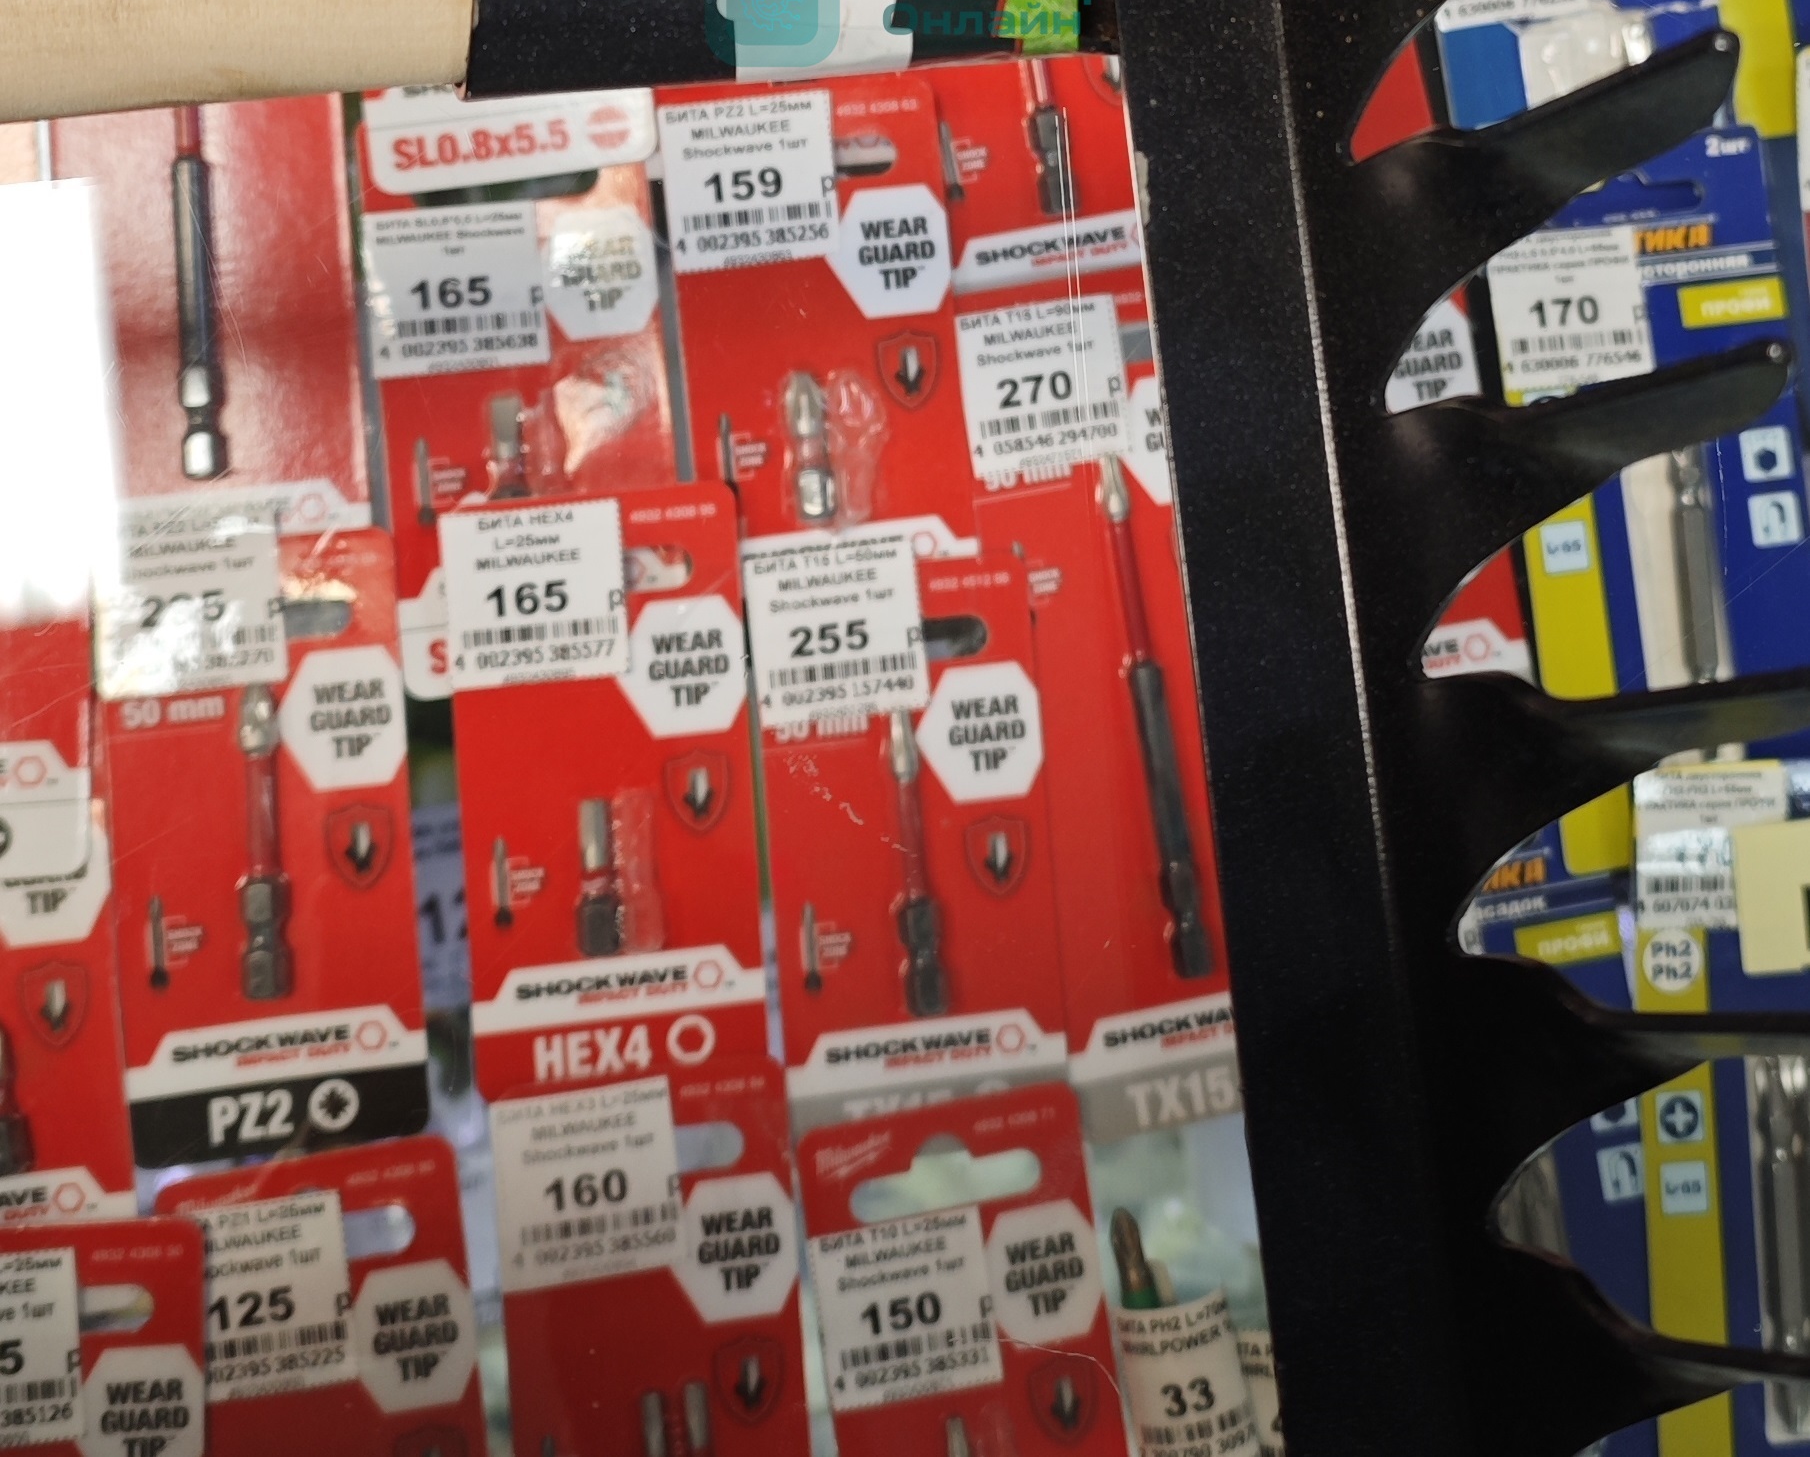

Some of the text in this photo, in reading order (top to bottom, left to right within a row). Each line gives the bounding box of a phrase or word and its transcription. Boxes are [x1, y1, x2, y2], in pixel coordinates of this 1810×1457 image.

[665, 100, 812, 124] БИТА PZ2 L=25мм
[691, 119, 790, 141] MILWAUKEE
[392, 119, 571, 171] SL0.8x5.5
[683, 139, 773, 160] Shockwave
[704, 167, 783, 203] 159
[696, 228, 762, 252] 002395
[860, 216, 927, 241] WEAR
[858, 240, 935, 266] GUARD
[975, 226, 1126, 266] SHOCKWAVE
[880, 266, 918, 290] TIP
[411, 275, 492, 311] 165
[960, 315, 1001, 331] БИТА
[1528, 295, 1600, 329] 170
[984, 321, 1077, 347] MILWAUKEE
[976, 344, 1061, 367] Shockwave
[996, 370, 1072, 409] 270
[1412, 378, 1448, 401] TIP
[477, 516, 524, 531] БИТА
[475, 548, 581, 572] MILWAUKEE
[753, 558, 797, 575] БИТА
[777, 568, 879, 593] MILWAUKEE
[487, 579, 569, 618] 165
[768, 591, 860, 614] Shockwave
[651, 628, 723, 655] WEAR
[790, 618, 870, 659] 255
[649, 654, 730, 681] GUARD
[313, 678, 385, 705] WEAR
[670, 682, 712, 707] TIP
[121, 696, 225, 729] 50 mm
[310, 704, 392, 733] GUARD
[951, 694, 1020, 720] WEAR
[332, 733, 372, 761] TIP
[949, 720, 1026, 746] GUARD
[970, 748, 1008, 772] TIP
[25, 887, 69, 914] TIP
[1651, 940, 1692, 958] Ph2
[516, 965, 689, 1001] SHOCKWAVE
[1652, 962, 1692, 981] Ph2
[1103, 1008, 1235, 1049] SHOCKWA
[171, 1025, 352, 1064] SHOCKWAVE
[533, 1024, 653, 1084] HEX4
[826, 1028, 991, 1065] SHOCKWAVE
[1126, 1066, 1238, 1130] TX15
[208, 1088, 296, 1146] PZ2
[544, 1168, 629, 1213] 160
[702, 1206, 774, 1236] WEAR
[698, 1233, 781, 1265] GUARD
[819, 1232, 865, 1253] БИТА
[845, 1236, 946, 1268] MILWAUKEE
[1006, 1231, 1078, 1266] WEAR
[720, 1263, 763, 1292] TIP
[837, 1264, 930, 1292] Shockwave
[1004, 1257, 1084, 1294] GUARD
[207, 1285, 296, 1331] 125
[375, 1292, 450, 1327] WEAR
[861, 1290, 941, 1335] 150
[1027, 1288, 1067, 1319] TIP
[372, 1320, 459, 1355] GUARD
[1150, 1315, 1182, 1332] PH2
[397, 1354, 439, 1383] TIP
[106, 1379, 184, 1406] WEAR
[1160, 1375, 1215, 1418] 33
[100, 1406, 190, 1435] GUARD
[123, 1436, 169, 1457] TIP
